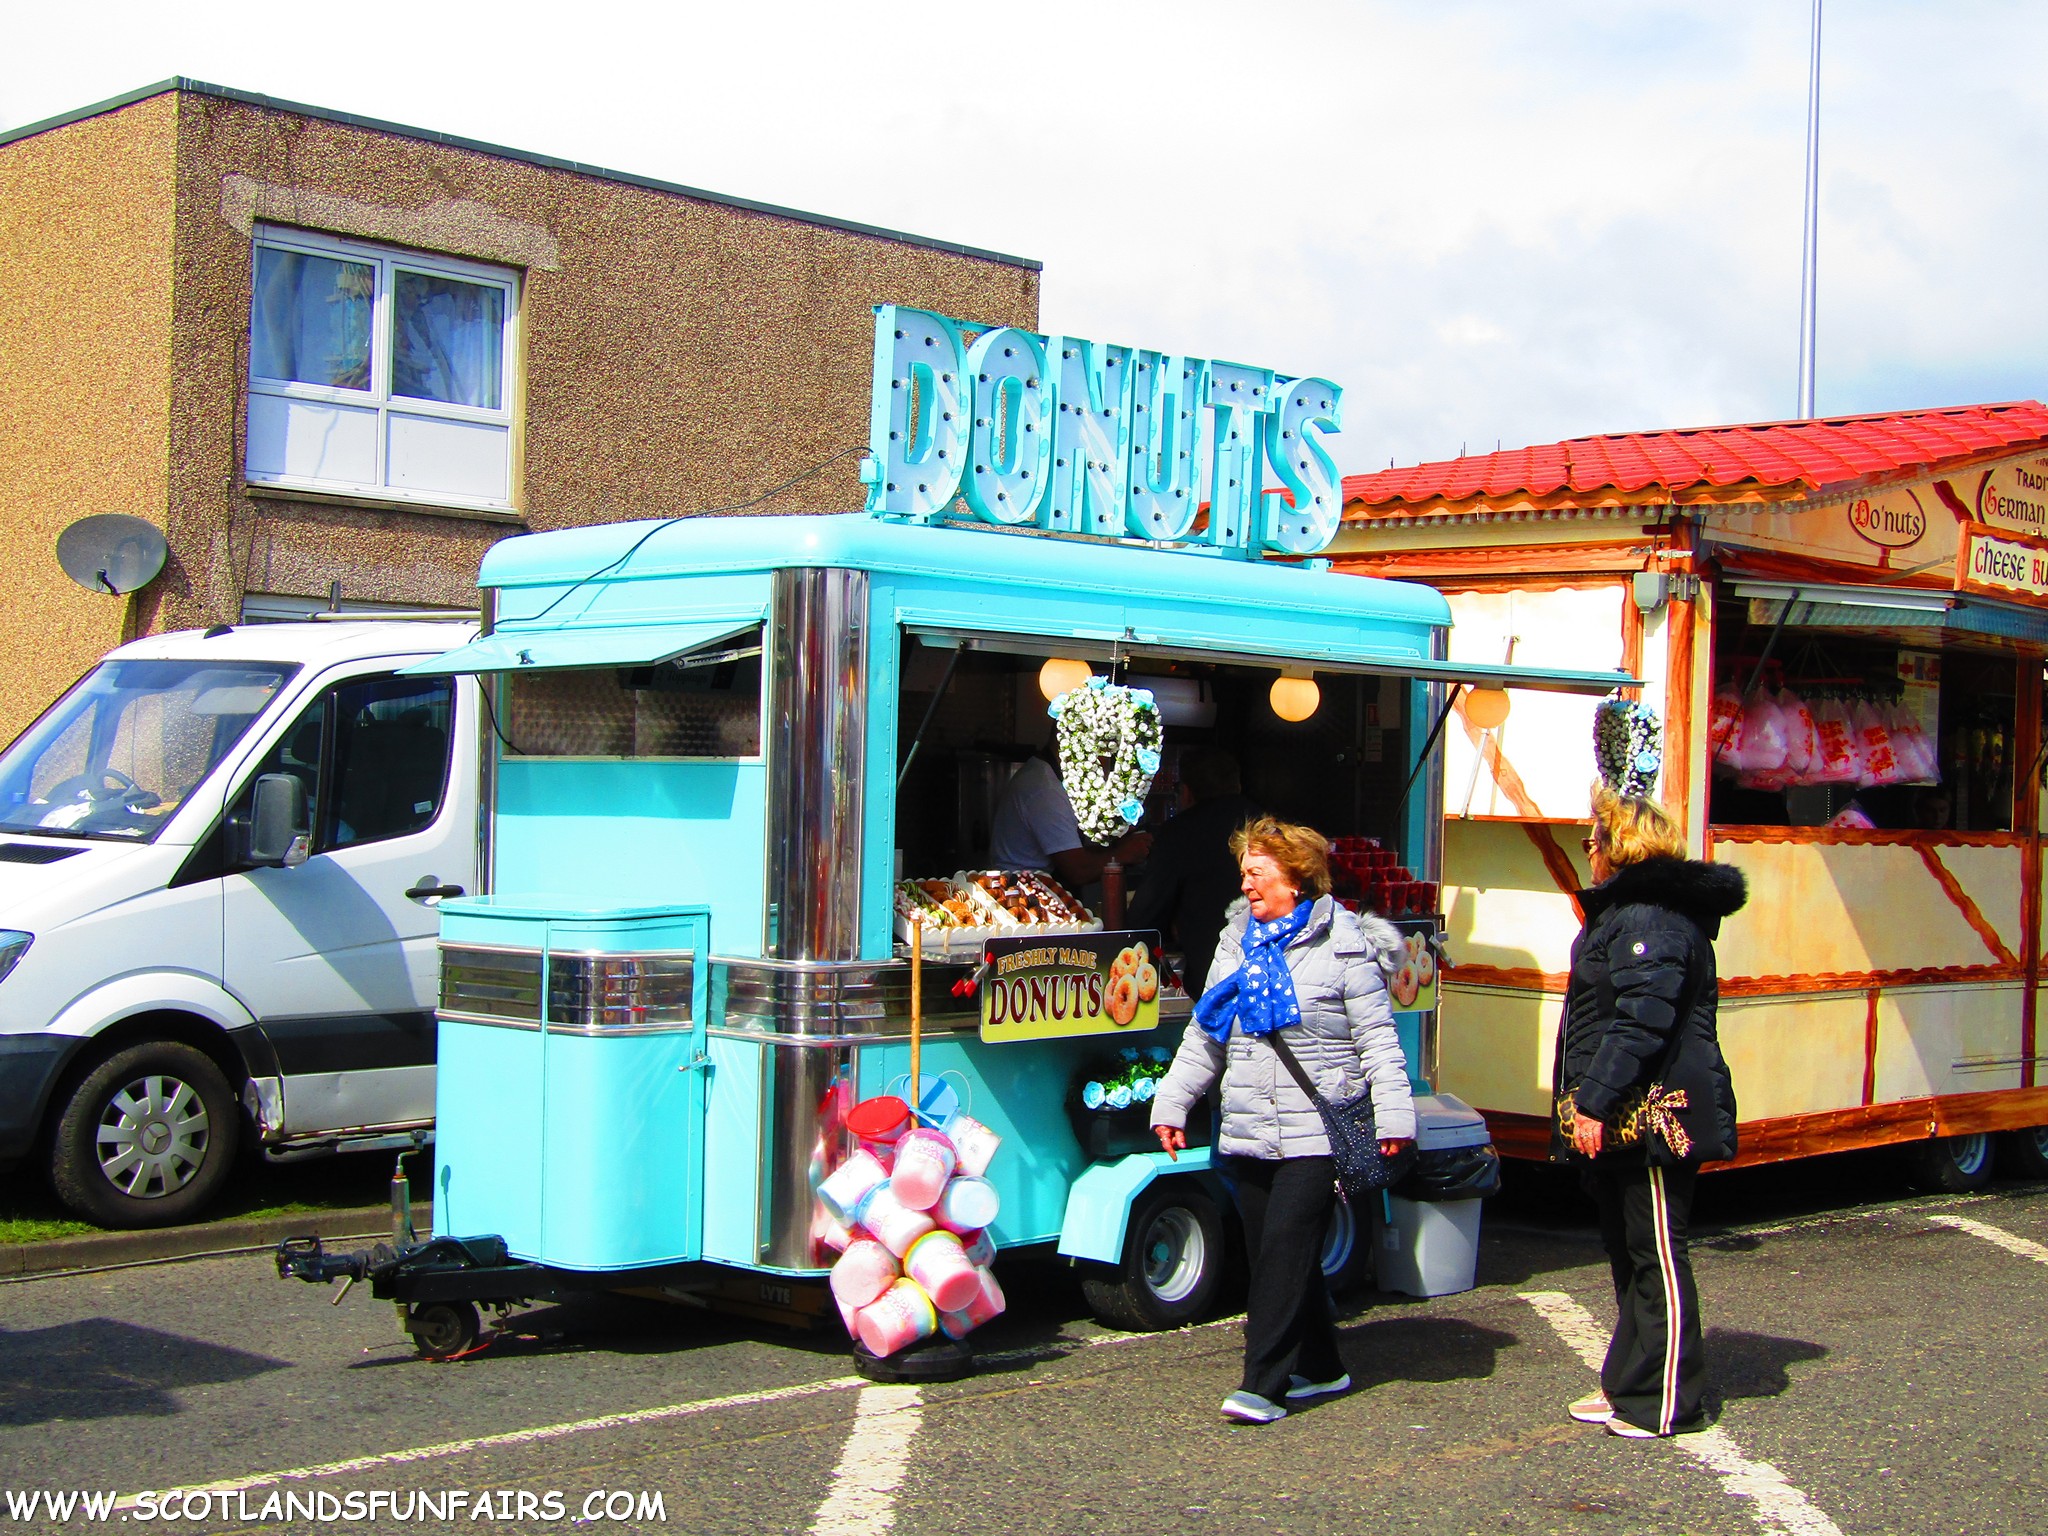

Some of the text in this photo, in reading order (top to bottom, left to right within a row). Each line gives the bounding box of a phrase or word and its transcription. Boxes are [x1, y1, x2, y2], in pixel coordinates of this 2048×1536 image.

[872, 304, 1344, 553] DONUTS
[2016, 467, 2048, 491] TRADI
[1855, 500, 1920, 536] Do'nuts
[997, 948, 1098, 975] FRESHLY MADE
[989, 972, 1103, 1025] DONUTS
[761, 1283, 791, 1304] LYTE
